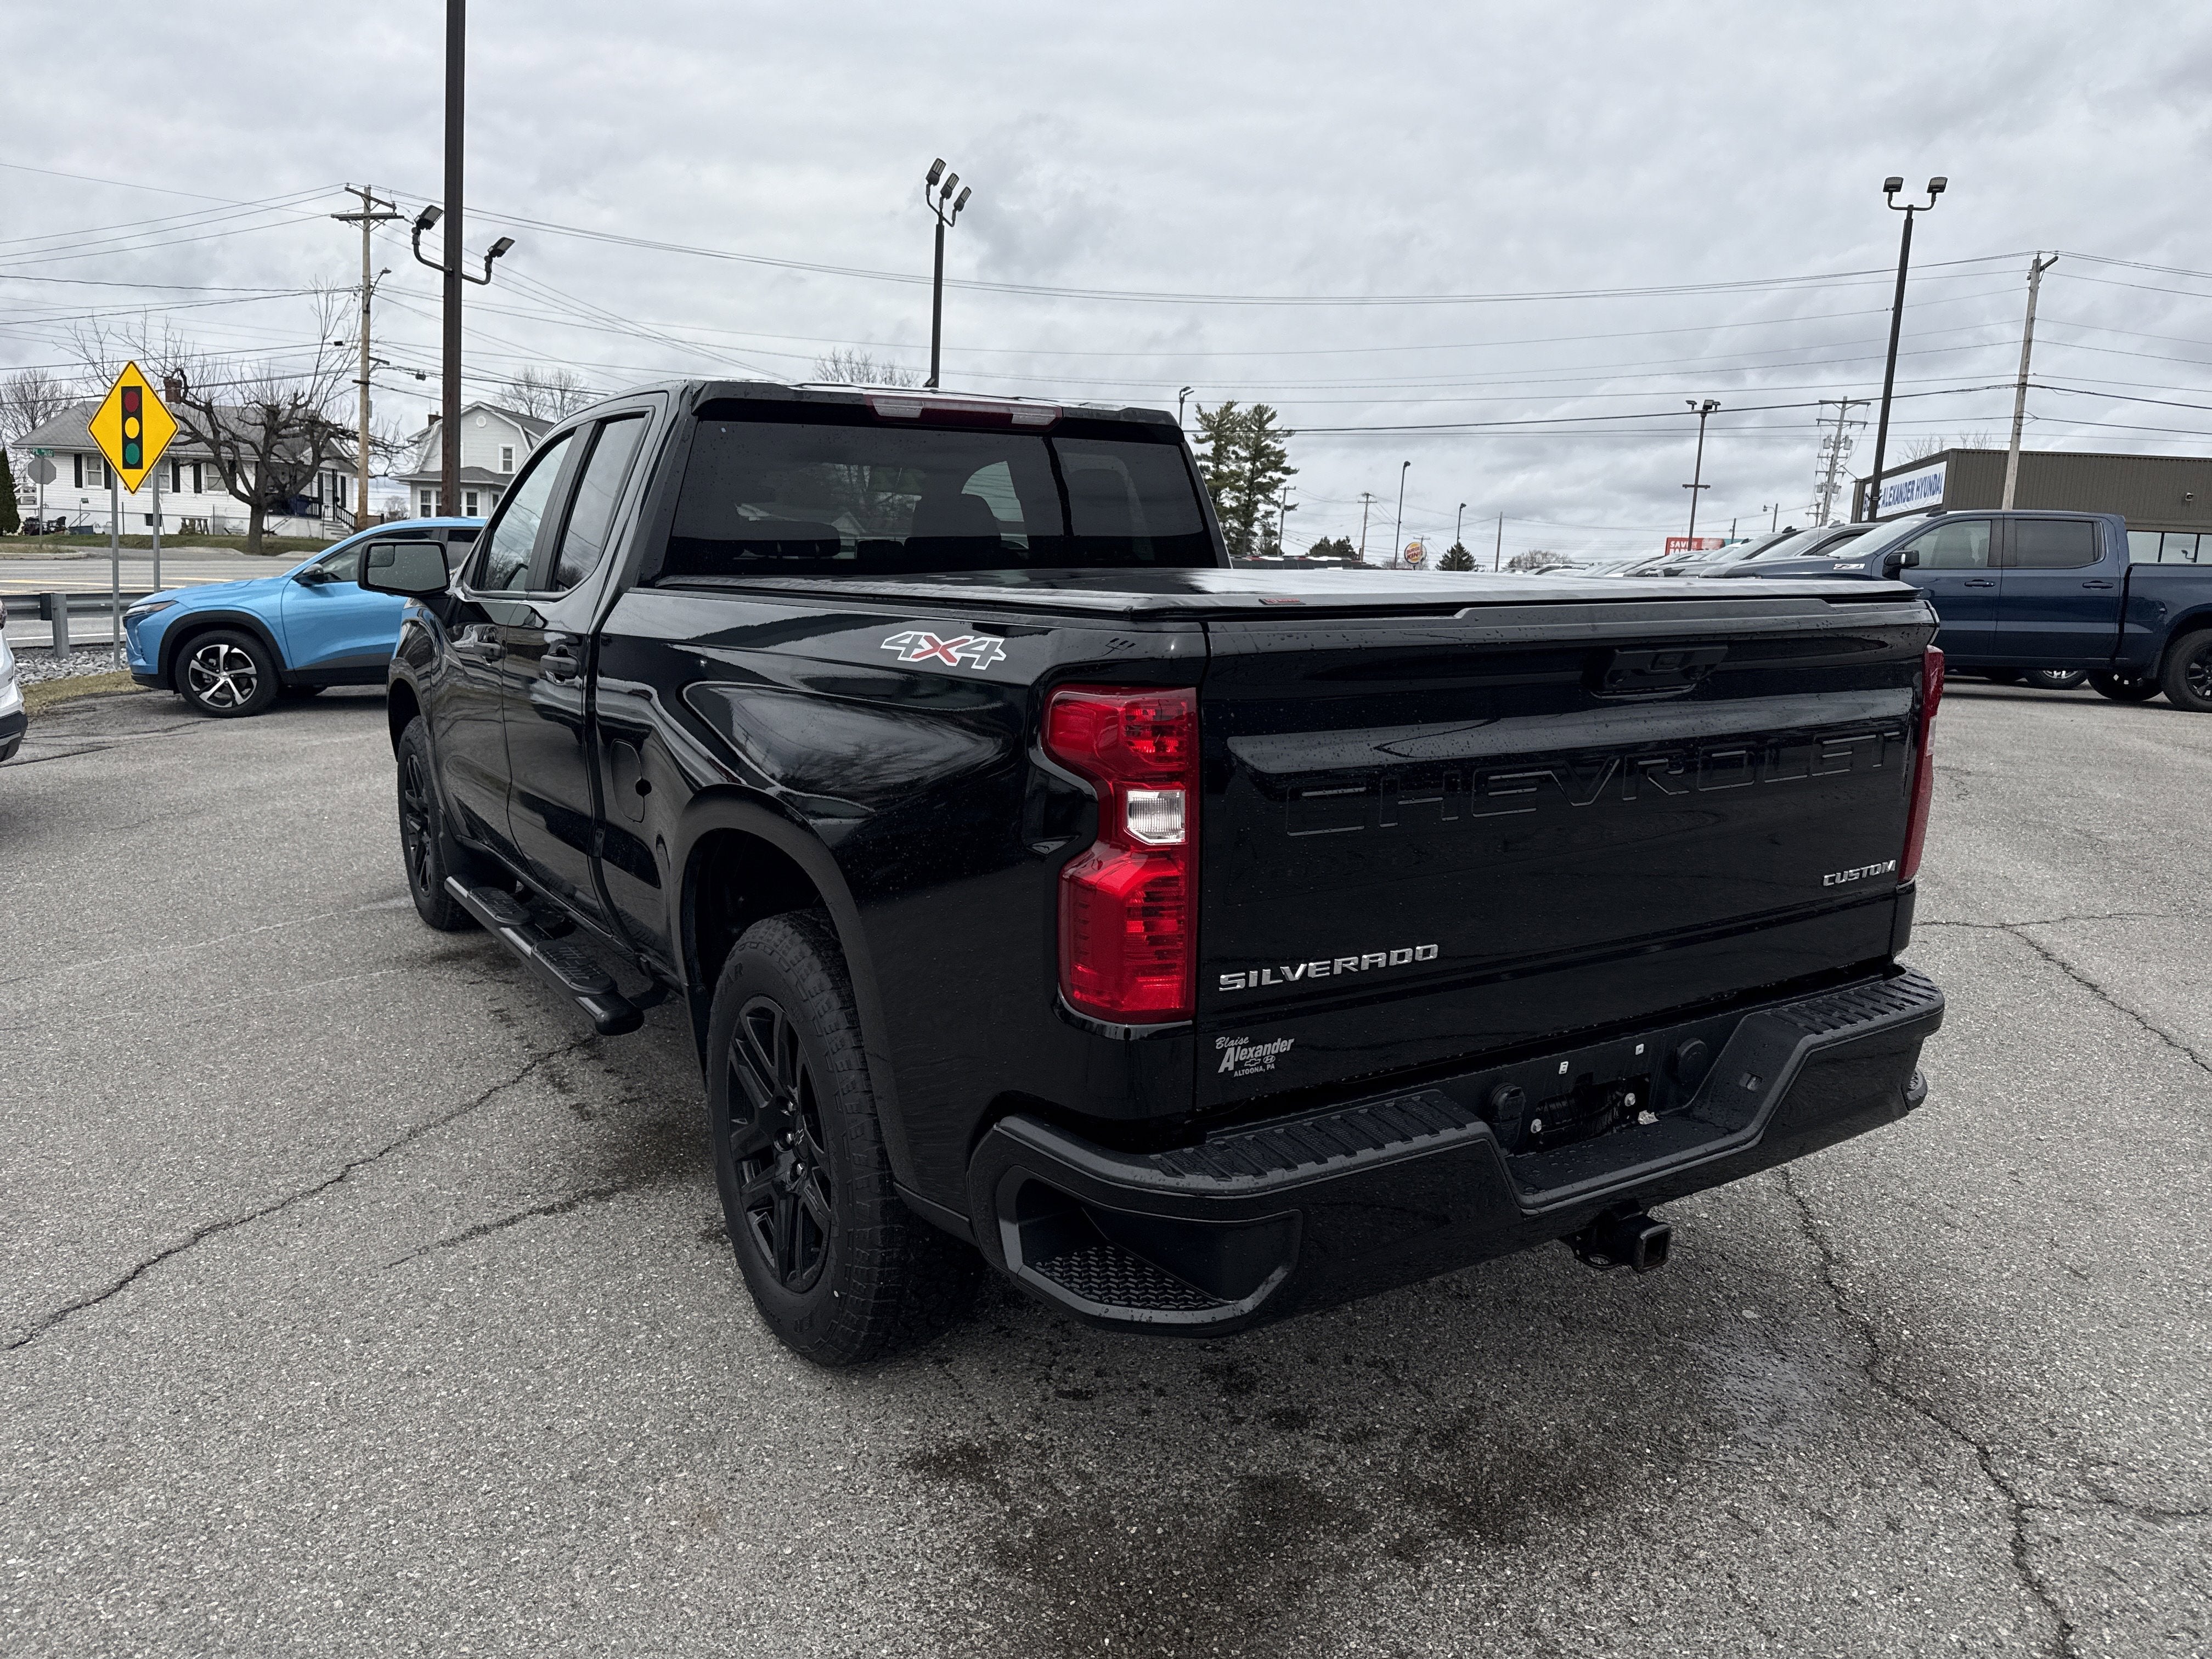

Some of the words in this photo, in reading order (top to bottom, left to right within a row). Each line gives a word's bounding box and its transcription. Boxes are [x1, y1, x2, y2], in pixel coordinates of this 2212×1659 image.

[1881, 480, 1915, 507] ALEXANDER
[1915, 472, 1943, 500] HYUNDAI
[1286, 726, 1900, 837] CHEVROLET
[1823, 860, 1896, 887] CUSTOM
[1219, 944, 1438, 991] SILVERADO
[1215, 1036, 1249, 1049] Blaise
[1217, 1037, 1295, 1073] Alexander
[1234, 1065, 1265, 1077] ALTOONA,
